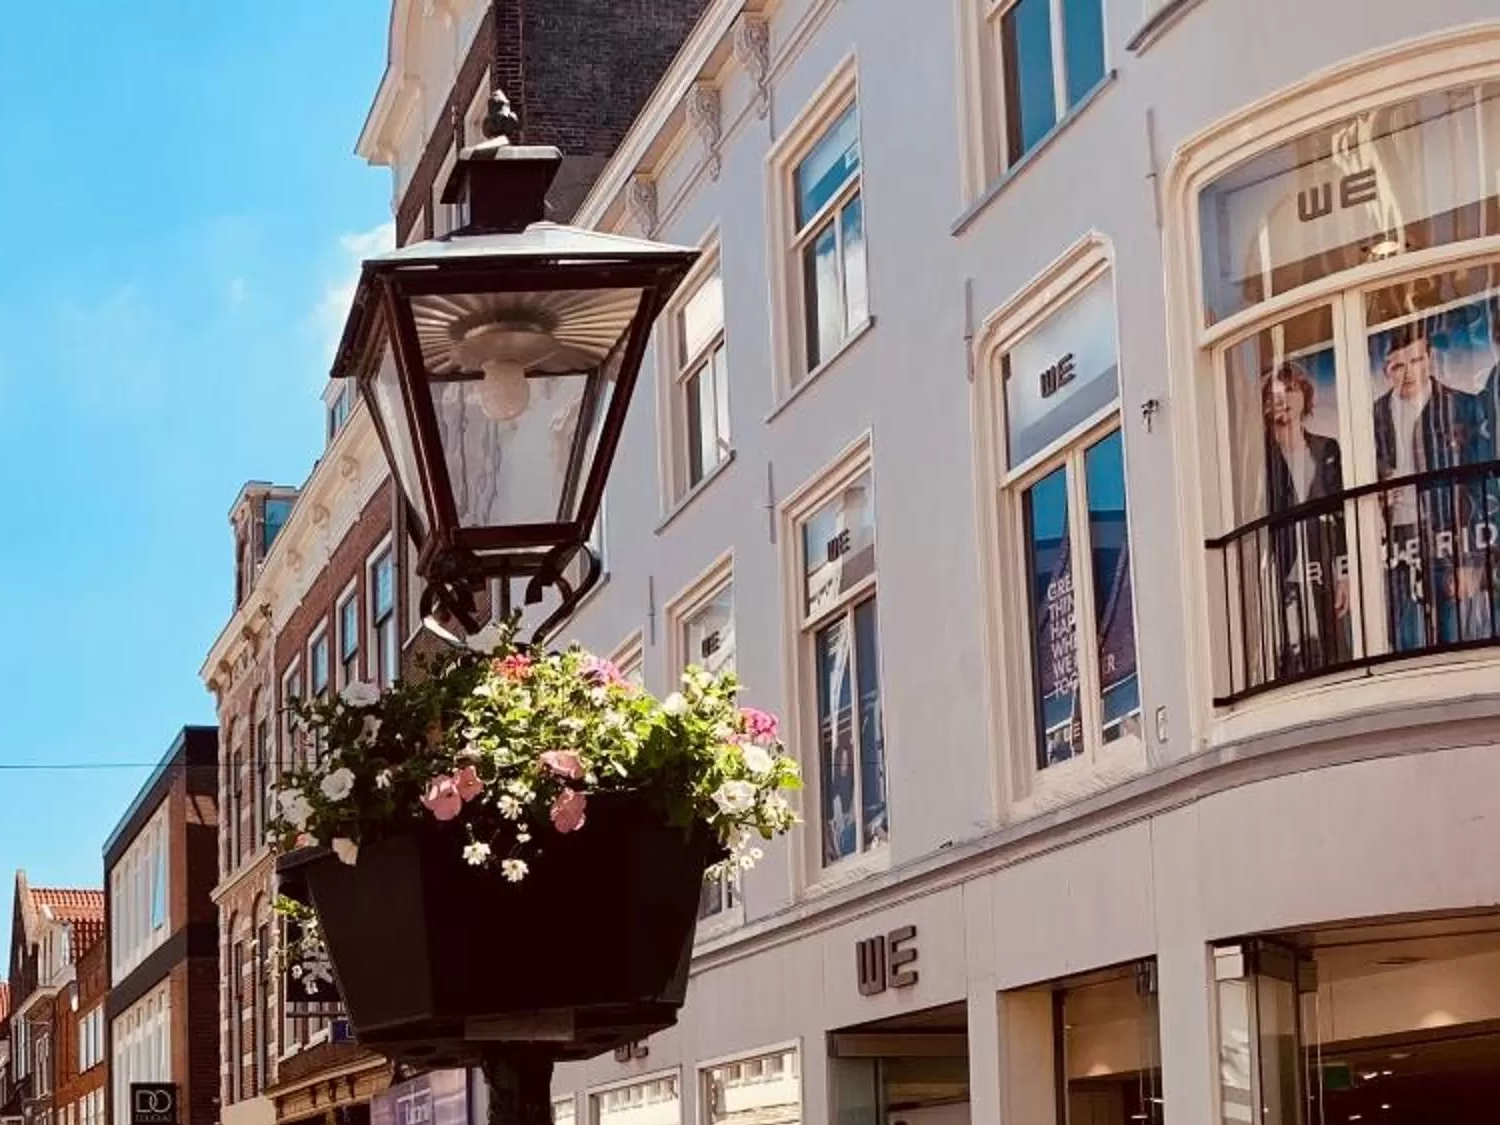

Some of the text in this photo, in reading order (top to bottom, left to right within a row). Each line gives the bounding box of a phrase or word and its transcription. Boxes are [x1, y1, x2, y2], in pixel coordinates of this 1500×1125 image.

[1298, 169, 1377, 222] WE
[1040, 353, 1076, 398] WE
[827, 528, 850, 562] WE
[1047, 575, 1074, 601] GRE
[856, 925, 918, 996] WE
